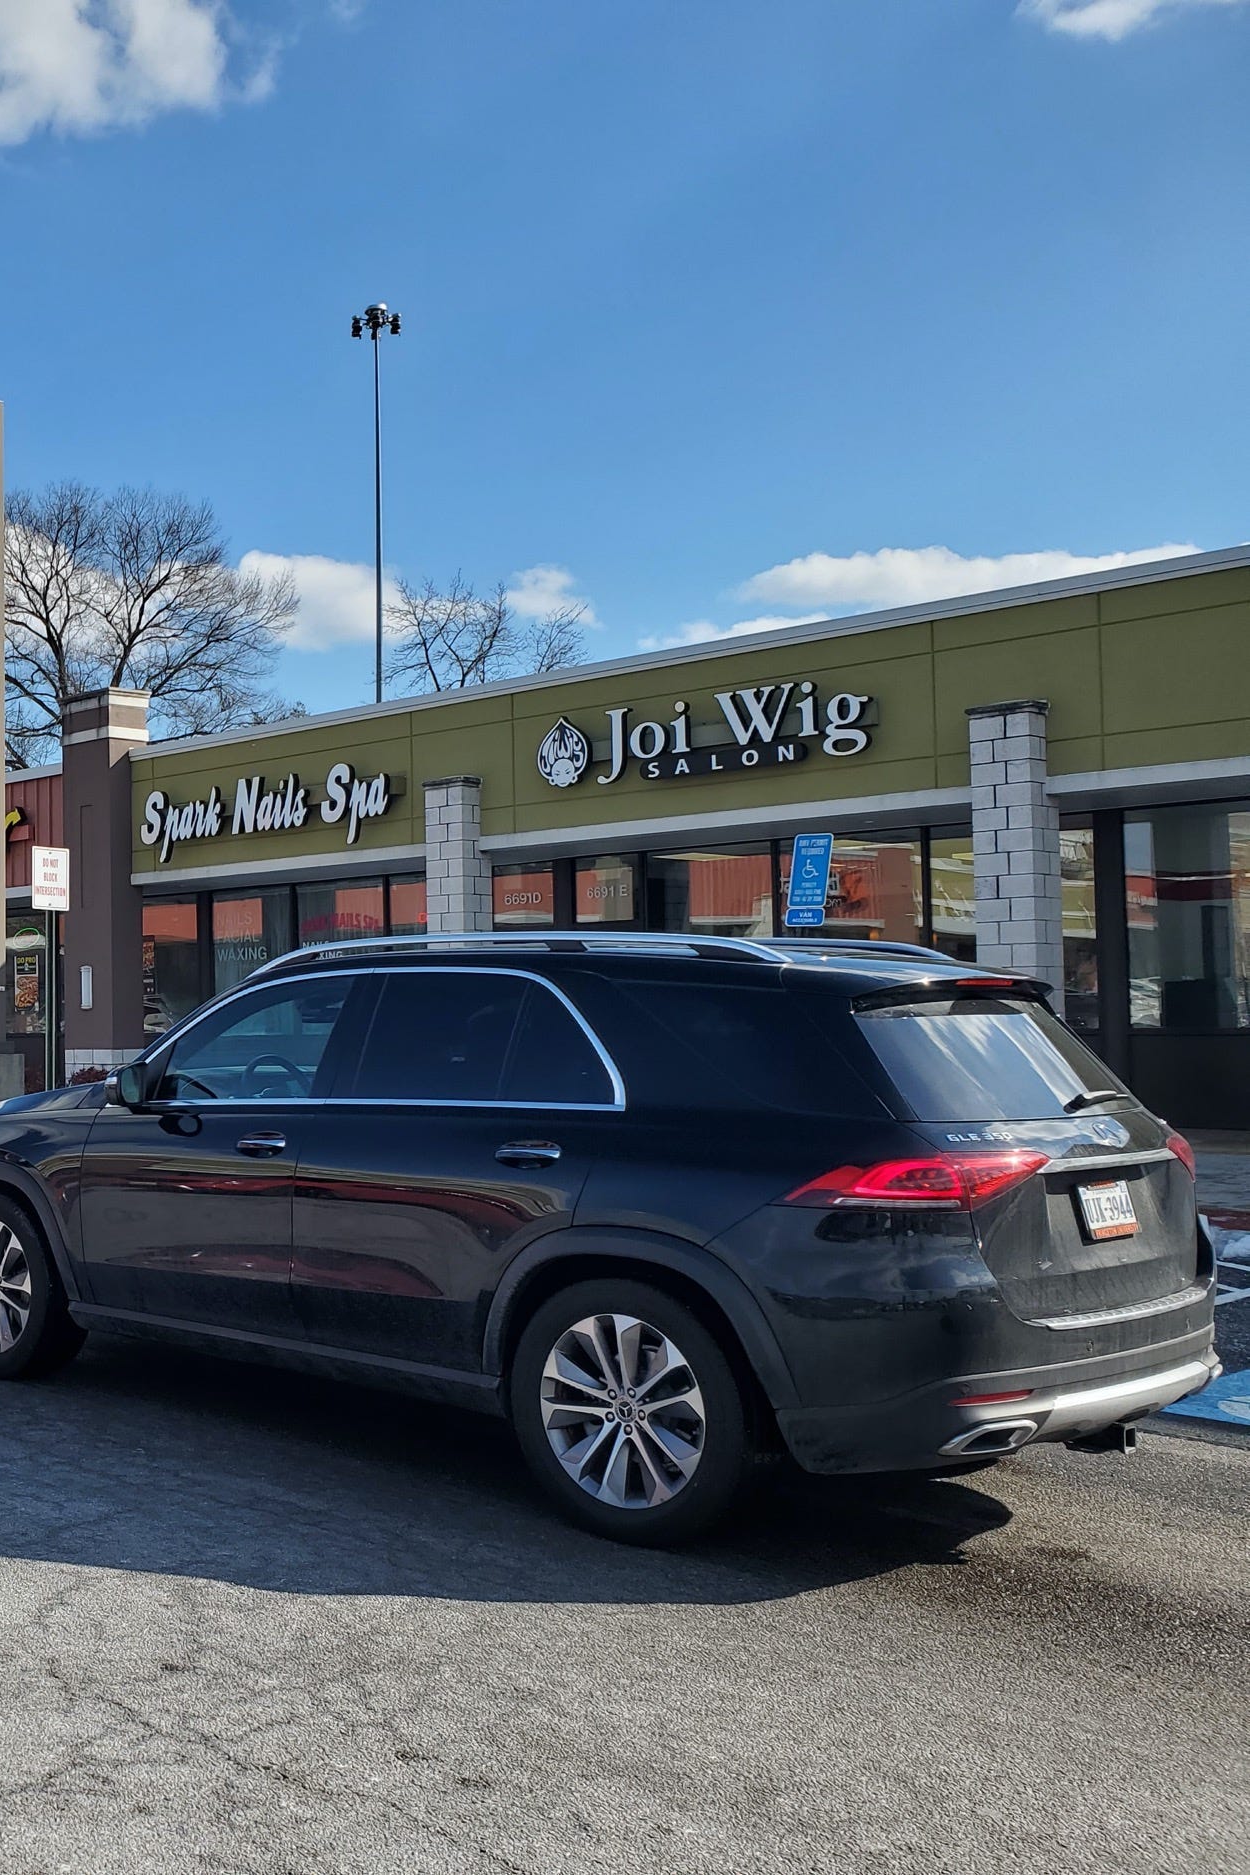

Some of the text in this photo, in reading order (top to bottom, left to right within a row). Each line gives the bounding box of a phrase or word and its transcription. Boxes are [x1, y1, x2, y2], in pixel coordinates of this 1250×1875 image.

[597, 680, 870, 785] Joi Wig
[647, 743, 795, 779] SALON
[140, 763, 390, 864] Spark Nails Spa
[42, 858, 59, 868] DO NOT
[43, 872, 58, 882] BLOCK
[35, 885, 66, 897] INTERSECTION
[586, 884, 629, 899] 6691 E
[504, 892, 542, 905] 6691D
[216, 911, 253, 925] NAILS
[216, 928, 260, 944] FACIAL
[217, 945, 268, 961] WAXING
[946, 1131, 1013, 1143] GLE 350
